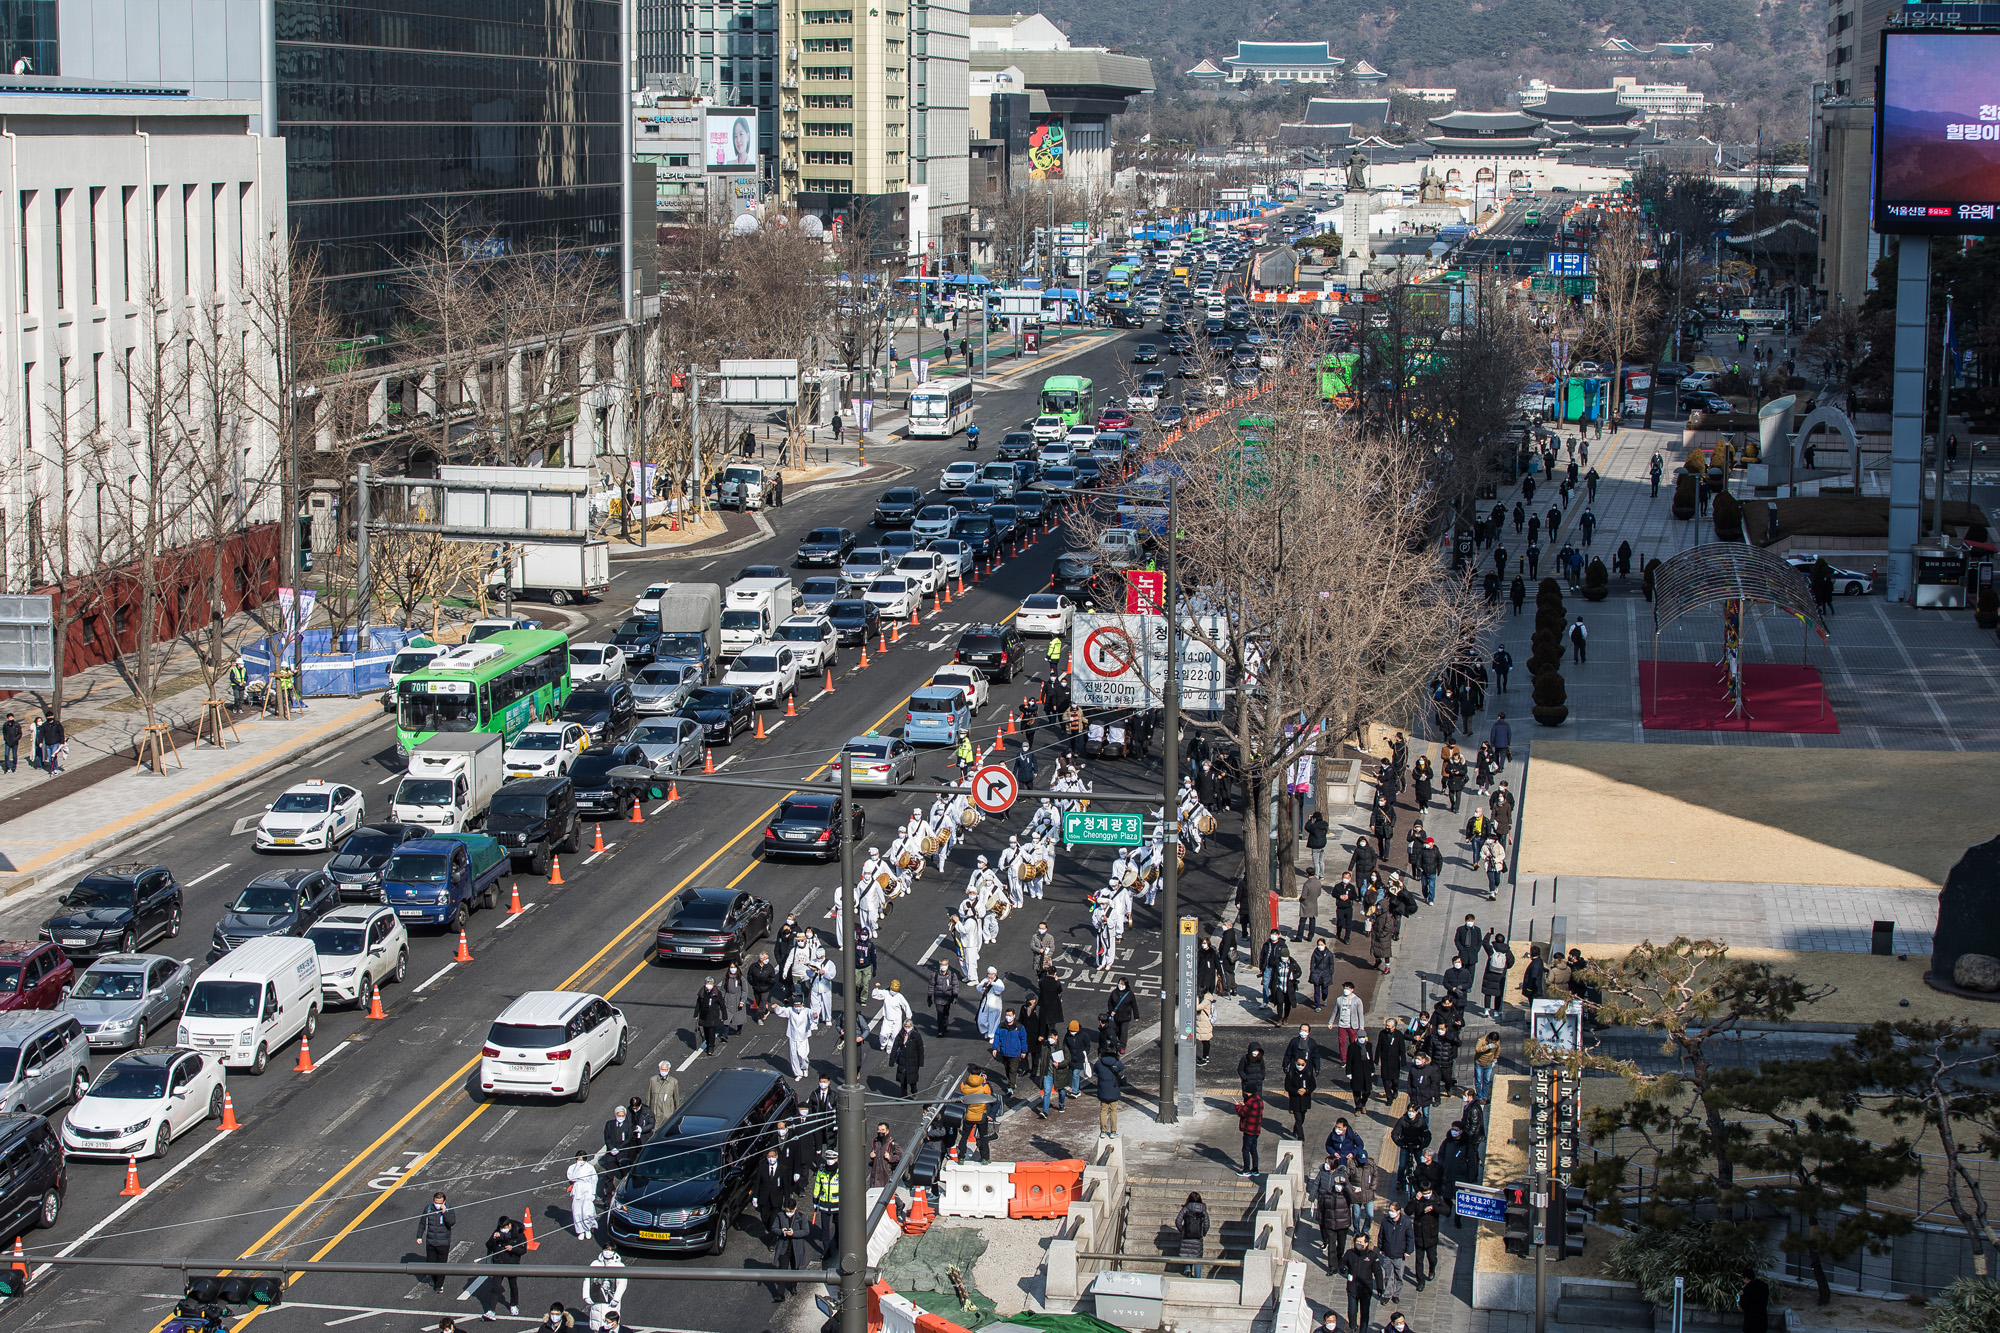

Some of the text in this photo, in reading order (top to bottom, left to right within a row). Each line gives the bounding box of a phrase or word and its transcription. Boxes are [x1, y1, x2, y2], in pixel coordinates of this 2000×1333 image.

[1979, 105, 2000, 121] 천
[1958, 205, 1994, 219] 유은혜
[411, 682, 428, 692] 7011
[400, 732, 414, 740] 7011
[1083, 816, 1138, 832] 청계광장
[1083, 830, 1138, 841] Cheonggye Plaza
